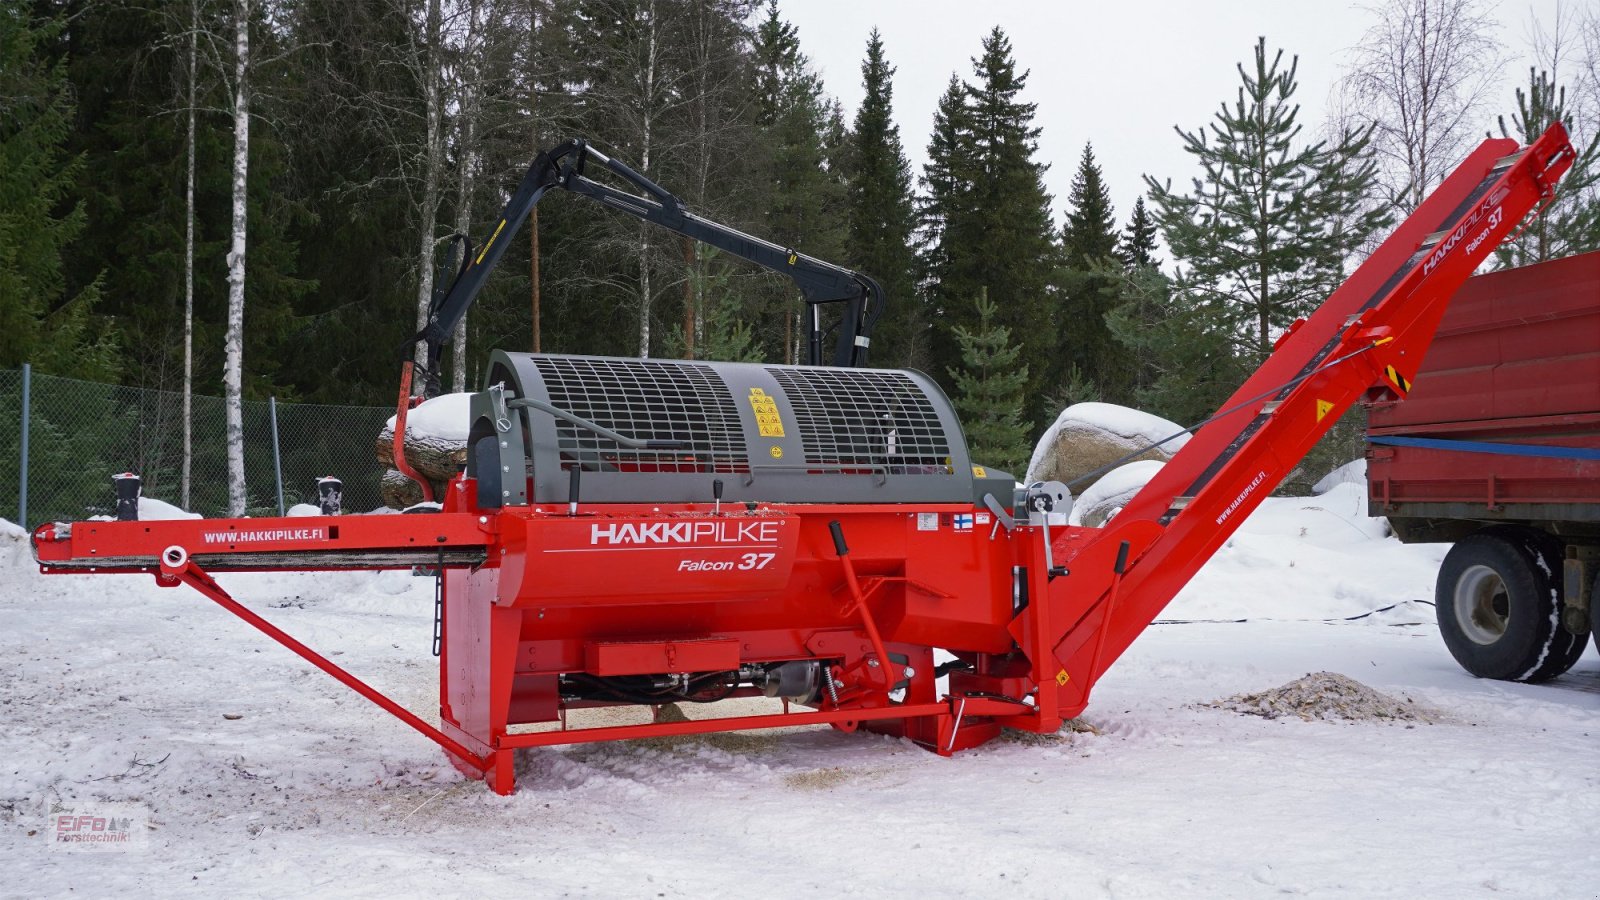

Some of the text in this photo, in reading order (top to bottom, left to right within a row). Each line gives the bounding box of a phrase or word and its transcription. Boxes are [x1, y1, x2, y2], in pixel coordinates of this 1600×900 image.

[1423, 191, 1498, 276] HAKKIPILKE
[1465, 205, 1502, 255] Falcon 37
[1215, 471, 1266, 525] WWW.HAKKIPILKE.FI
[204, 529, 323, 543] WWW.HAKKIPILKE.FI
[677, 553, 776, 571] Falcon 37
